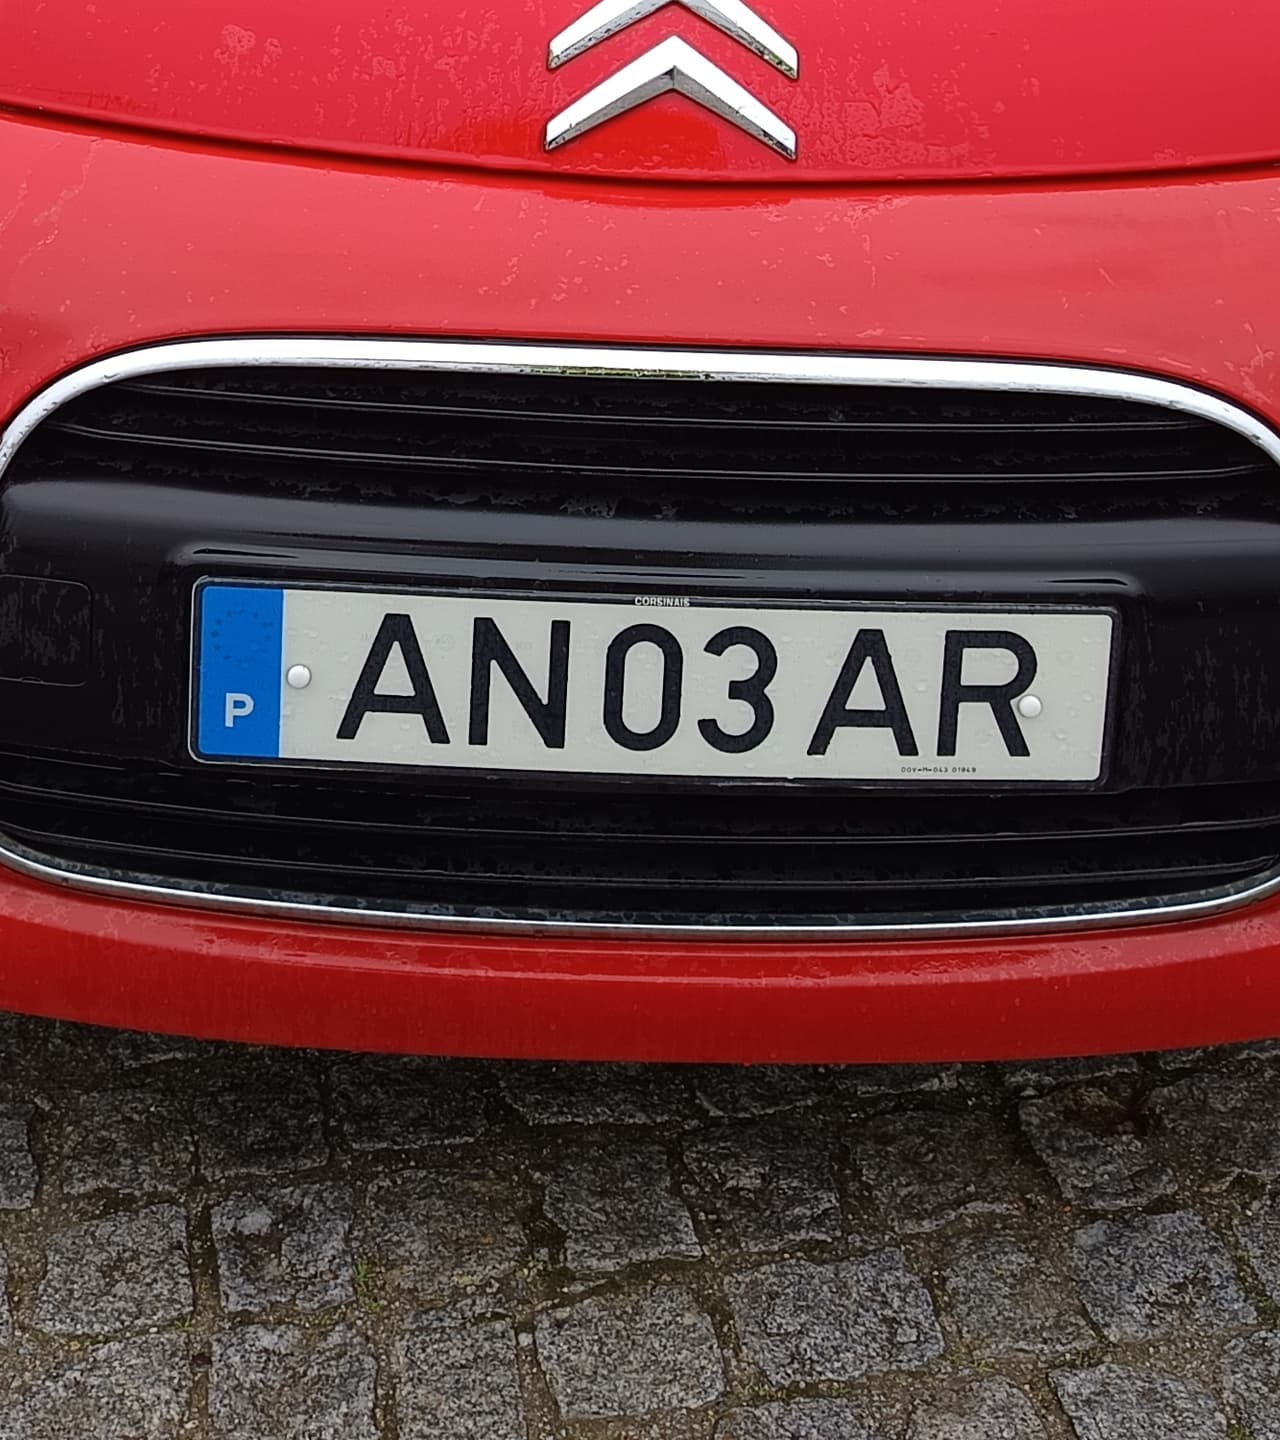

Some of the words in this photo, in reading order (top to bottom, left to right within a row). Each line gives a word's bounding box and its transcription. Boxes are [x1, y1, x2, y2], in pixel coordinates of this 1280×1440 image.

[634, 596, 691, 608] CORSINAIS
[336, 613, 571, 749] AN
[603, 623, 778, 754] 03
[806, 628, 1038, 757] AR
[224, 692, 255, 728] P
